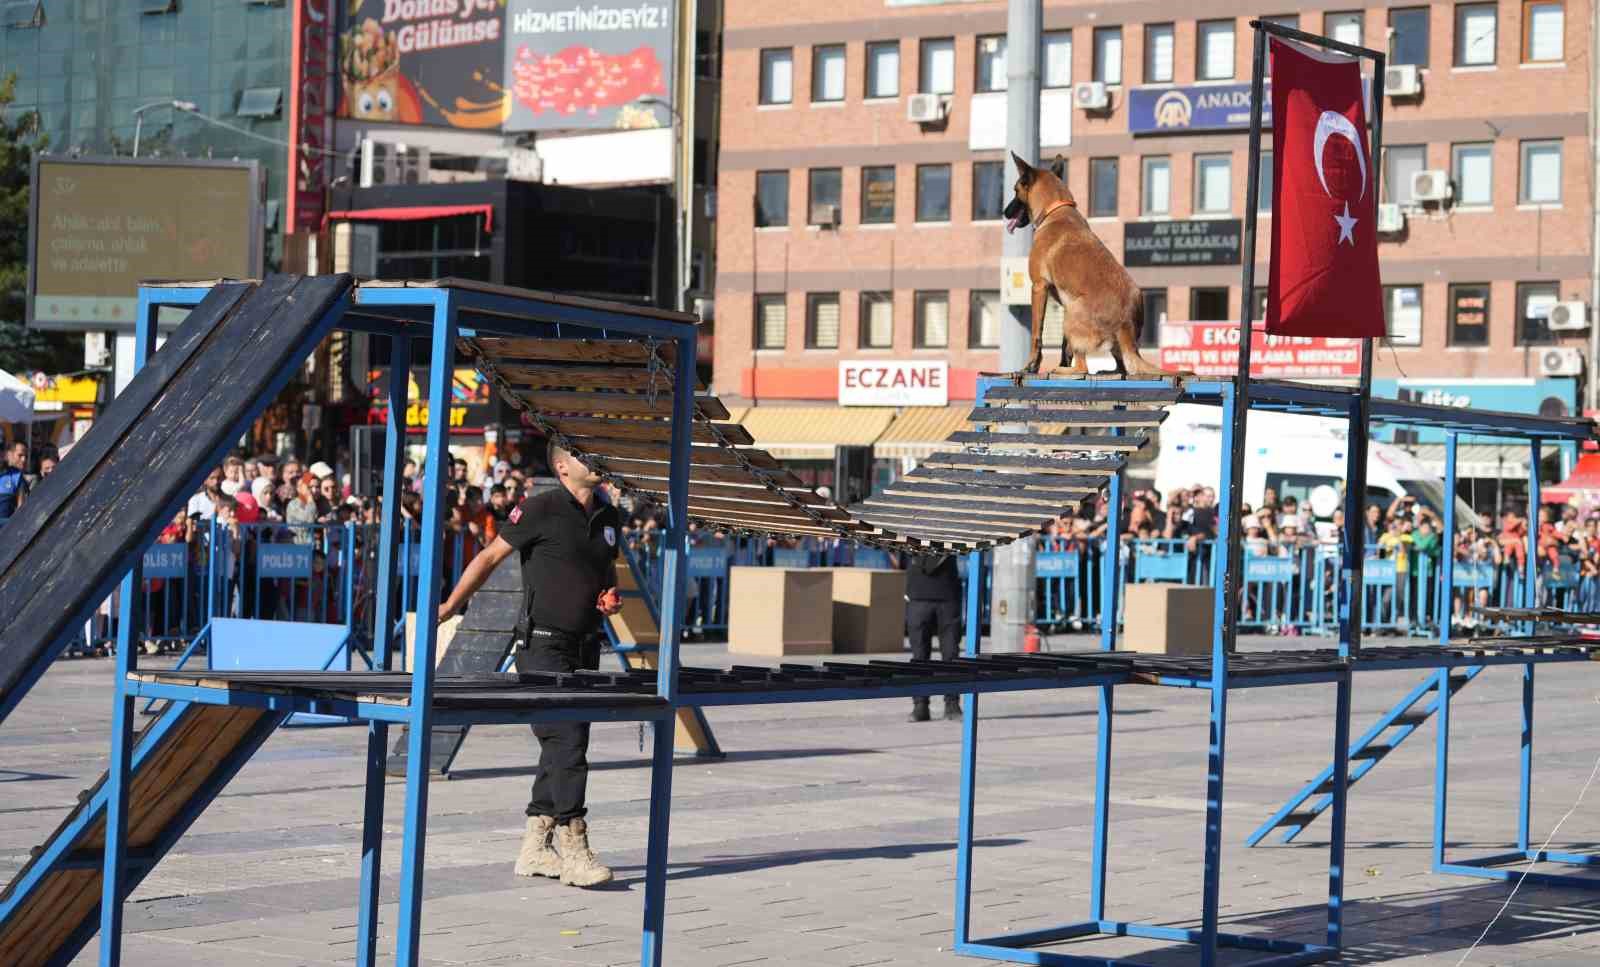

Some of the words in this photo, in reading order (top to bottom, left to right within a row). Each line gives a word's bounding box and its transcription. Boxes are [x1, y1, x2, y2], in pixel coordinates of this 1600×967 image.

[513, 4, 658, 33] HİZMETİNİZDEYİZ
[397, 18, 500, 52] Gülümse
[845, 367, 941, 388] ECZANE
[143, 551, 168, 568] OLİS
[170, 552, 183, 568] 71
[262, 551, 293, 568] POLİS
[295, 552, 309, 568] 71
